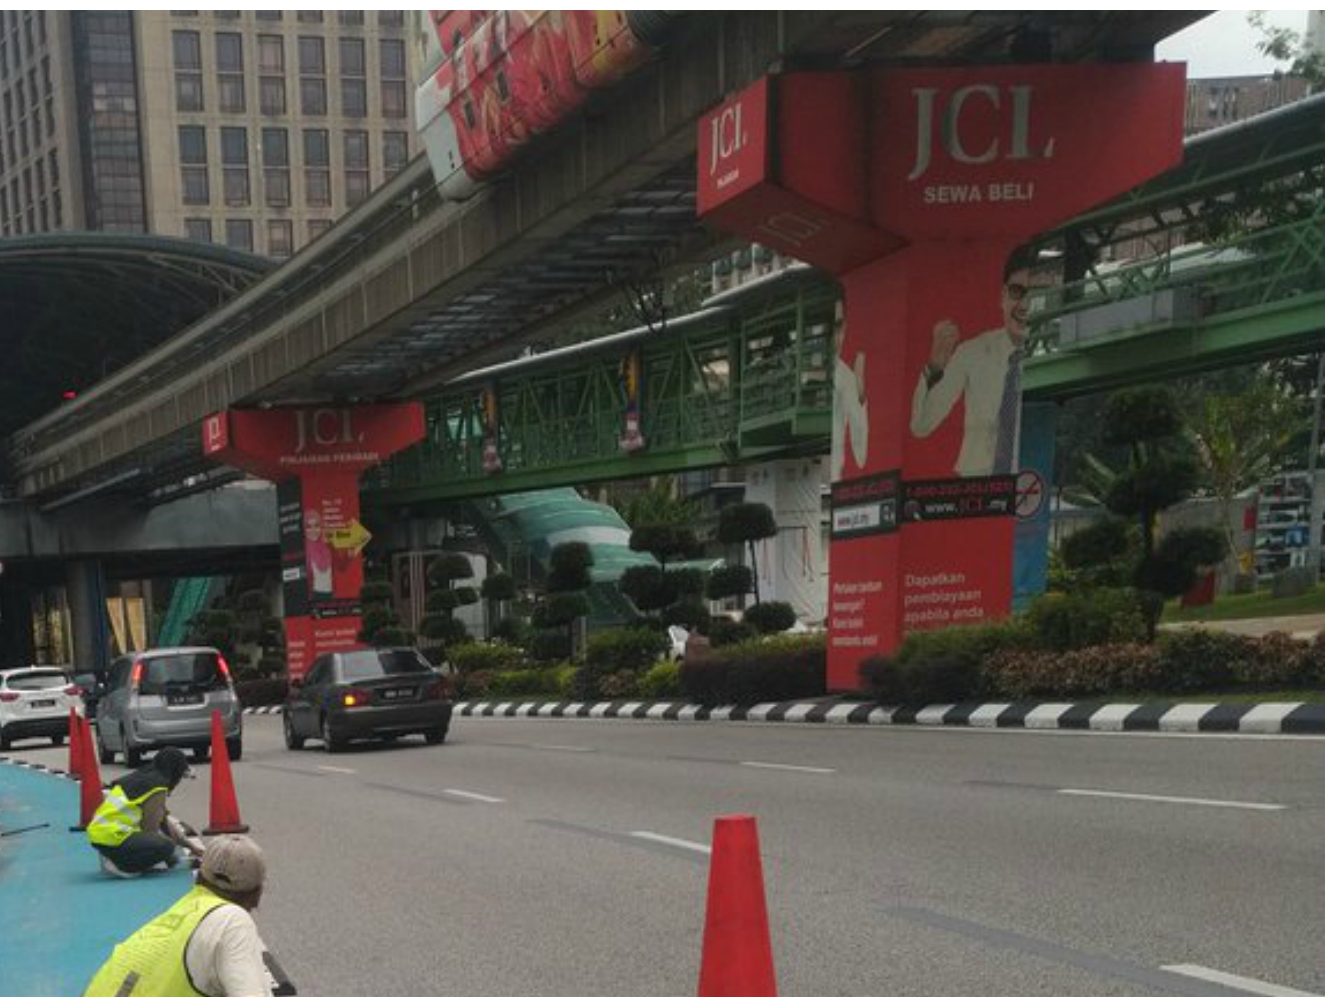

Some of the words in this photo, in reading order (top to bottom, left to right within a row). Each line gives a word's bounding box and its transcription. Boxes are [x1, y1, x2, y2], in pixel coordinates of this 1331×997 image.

[923, 185, 982, 203] SEWA
[989, 182, 1034, 201] BELI
[905, 573, 966, 588] Dapatkan
[904, 589, 982, 606] pembiayaan
[904, 607, 950, 624] apabila
[953, 606, 984, 619] anda
